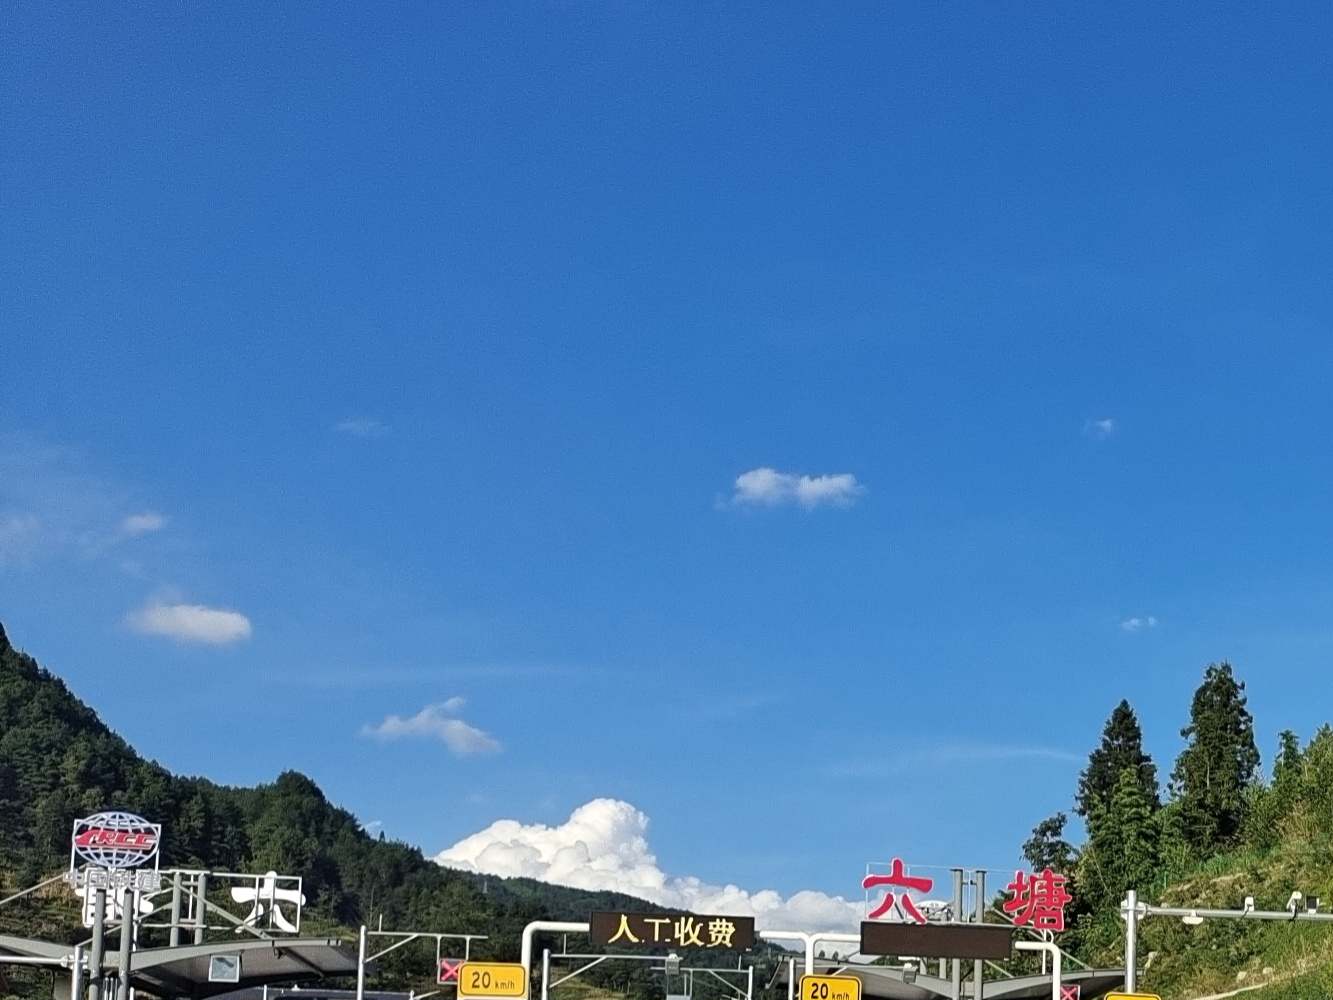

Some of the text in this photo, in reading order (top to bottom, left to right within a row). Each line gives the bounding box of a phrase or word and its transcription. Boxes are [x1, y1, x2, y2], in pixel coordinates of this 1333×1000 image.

[862, 858, 1073, 932] 六塘
[608, 914, 735, 948] 人工收费
[471, 971, 515, 990] 20 km/h
[811, 982, 850, 1000] 20 km/h
